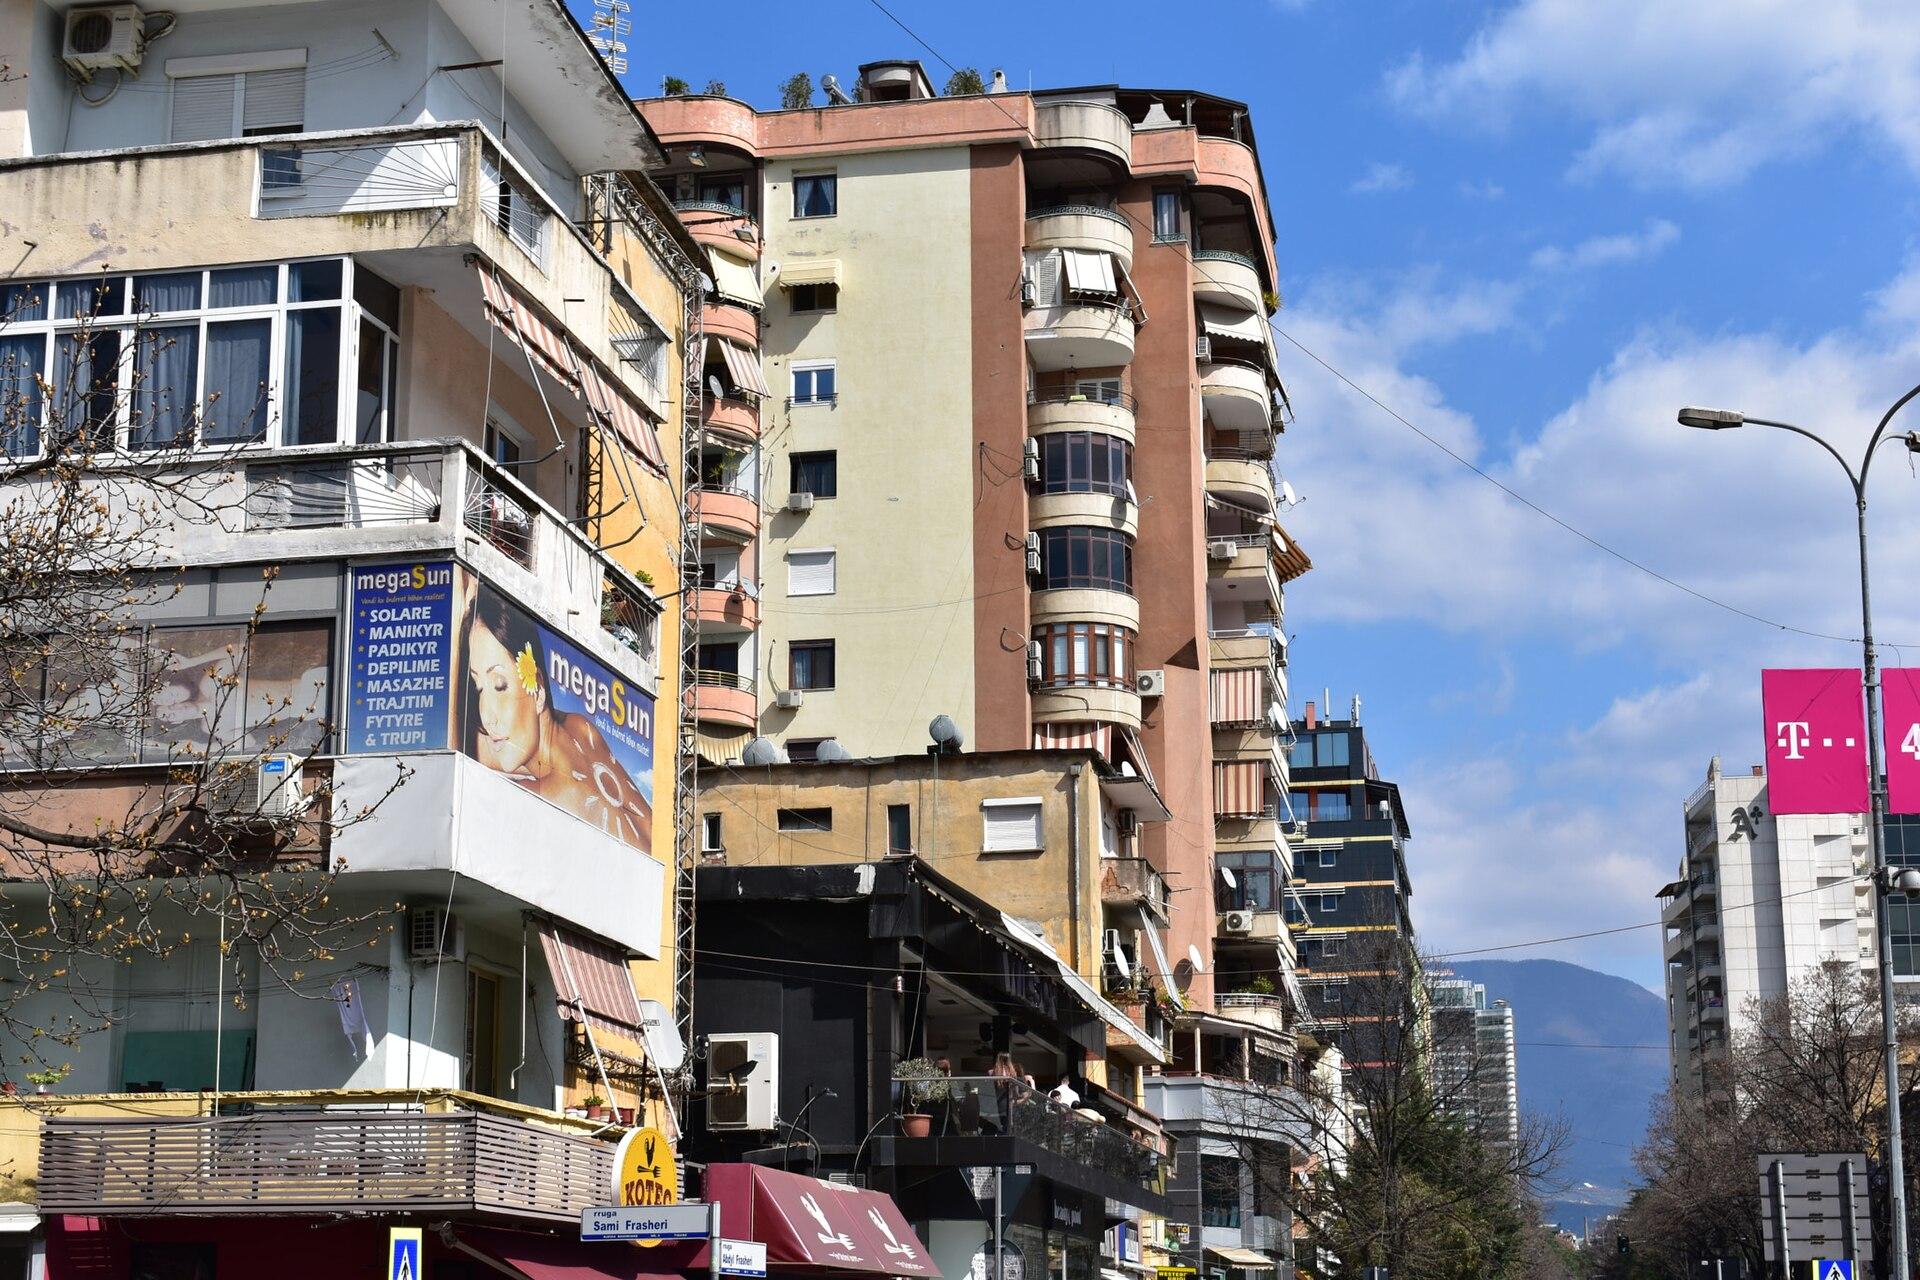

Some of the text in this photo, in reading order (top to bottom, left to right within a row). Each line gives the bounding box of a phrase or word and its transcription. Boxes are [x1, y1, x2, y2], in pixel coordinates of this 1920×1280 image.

[357, 564, 450, 594] megaSun
[370, 606, 431, 622] SOLARE
[369, 623, 443, 640] MANIKYR
[368, 641, 438, 657] PADIKYR
[367, 659, 440, 675] DEPILIME
[367, 676, 444, 693] MASAZHE
[550, 648, 650, 739] megaSun
[367, 695, 434, 711] TRAJTIM
[366, 713, 423, 729] FYTYRE
[365, 731, 426, 746] & TRUPI
[593, 1219, 668, 1231] Sami Frasheri
